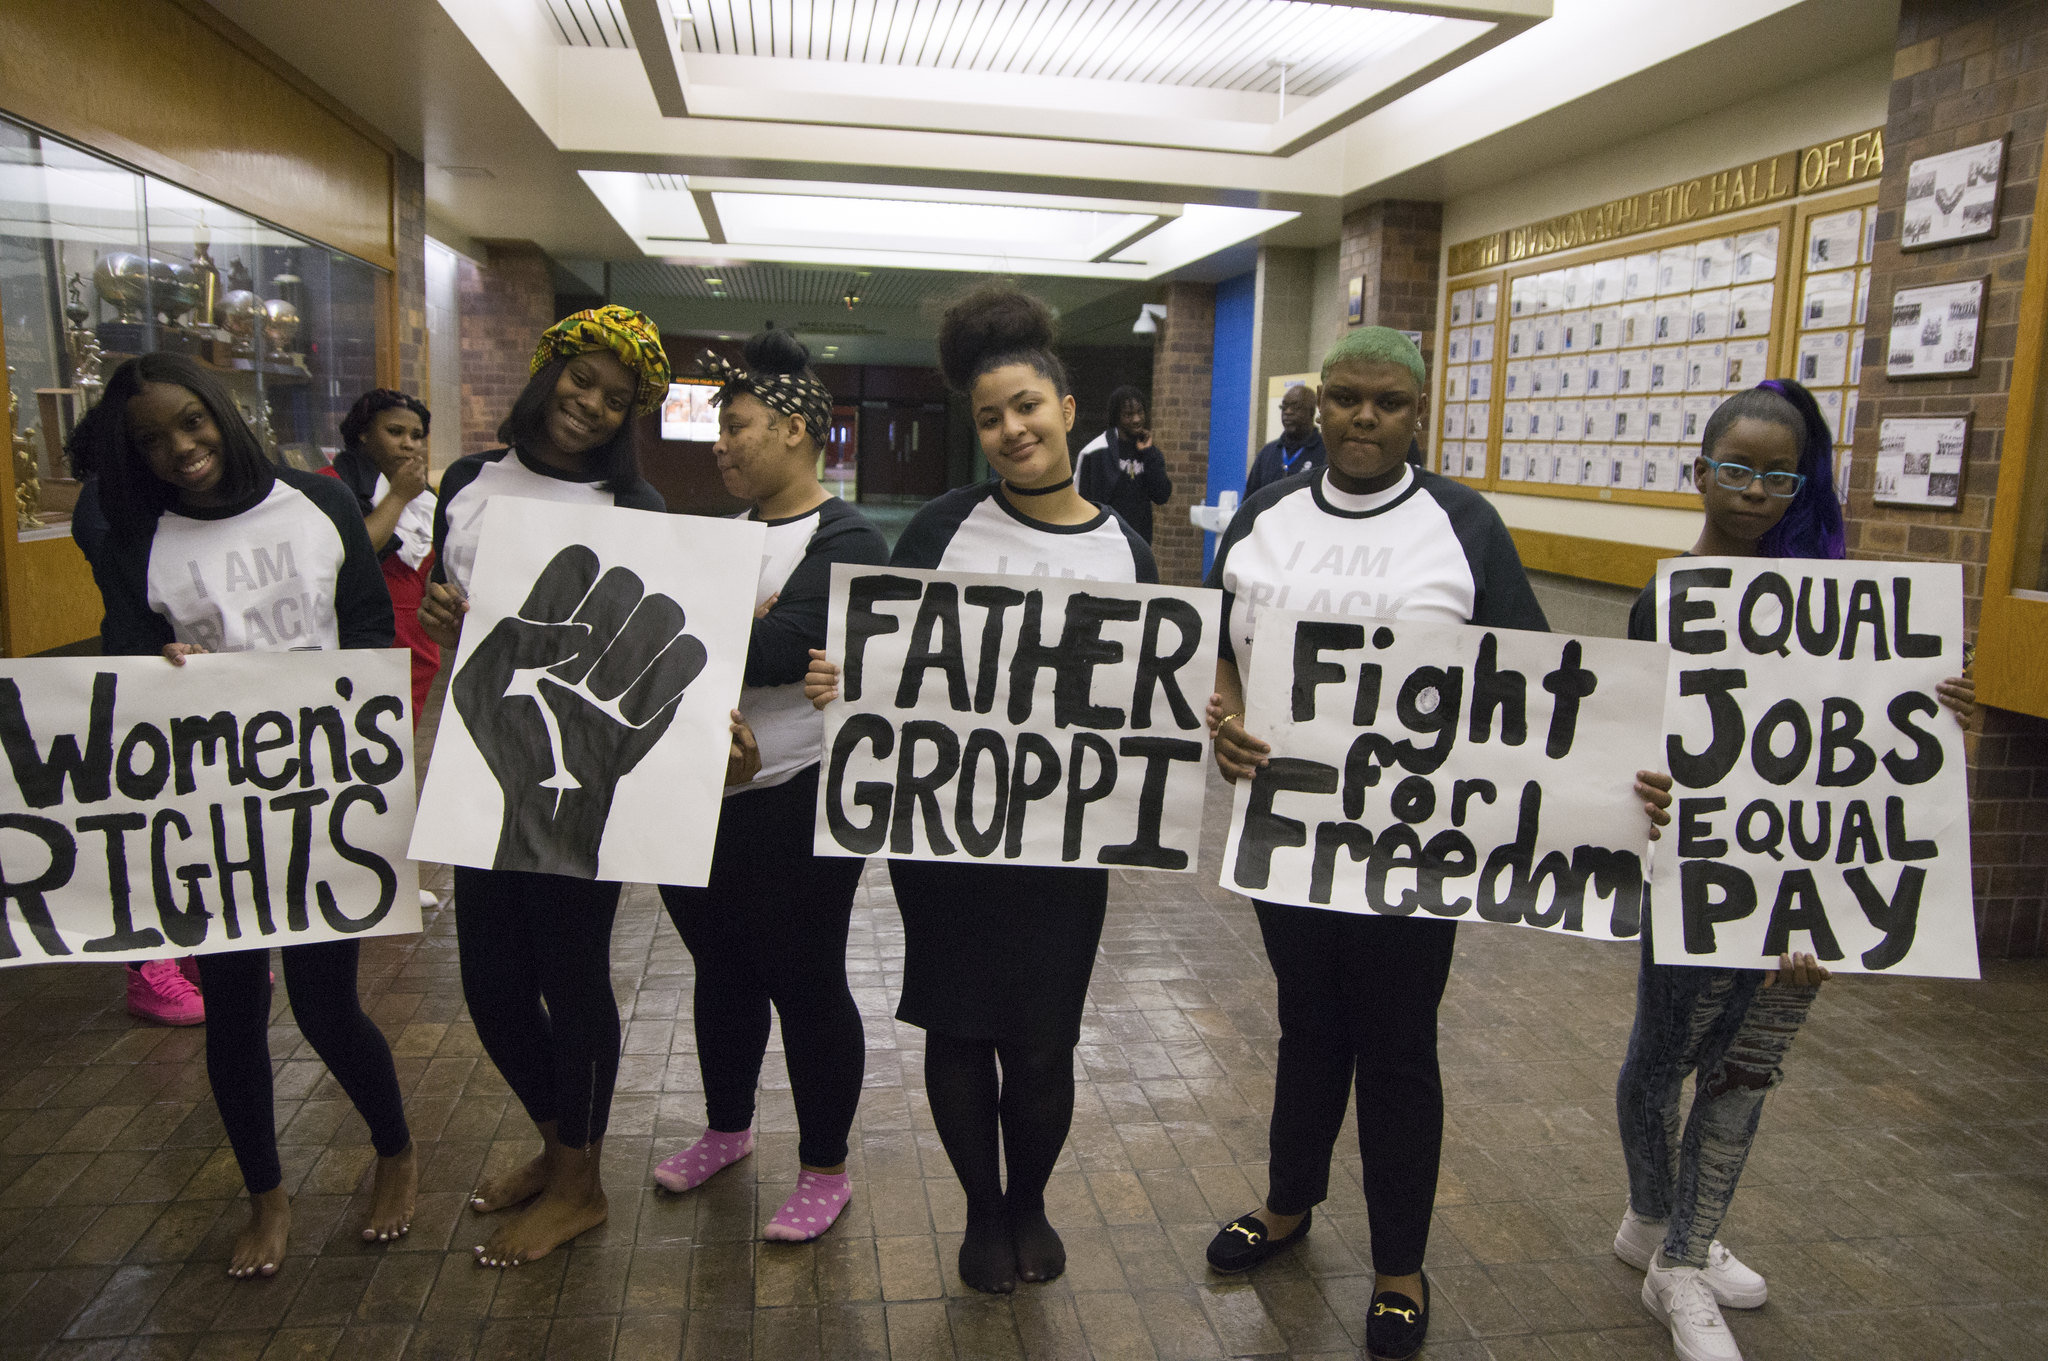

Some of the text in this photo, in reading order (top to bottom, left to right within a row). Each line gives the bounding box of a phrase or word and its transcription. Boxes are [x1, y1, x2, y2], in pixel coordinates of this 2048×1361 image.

[1510, 211, 1590, 260] DIVISION
[1592, 181, 1701, 240] ATHLETIC
[1708, 158, 1788, 212] HALL
[1802, 141, 1845, 190] OF
[187, 541, 298, 598] I AM
[1285, 541, 1395, 578] I AM
[1668, 567, 1942, 661] EQUAL
[844, 574, 1203, 730] FATHER
[1291, 621, 1598, 775] Fight
[0, 672, 404, 808] Women's
[1342, 732, 1497, 827] for
[1666, 668, 1944, 789] JOBS
[826, 713, 1203, 870] GROPPI
[1234, 757, 1643, 938] Freedom
[1678, 796, 1938, 864] EQUAL
[0, 785, 398, 960] RIGHTS
[1679, 859, 1927, 970] PAY
